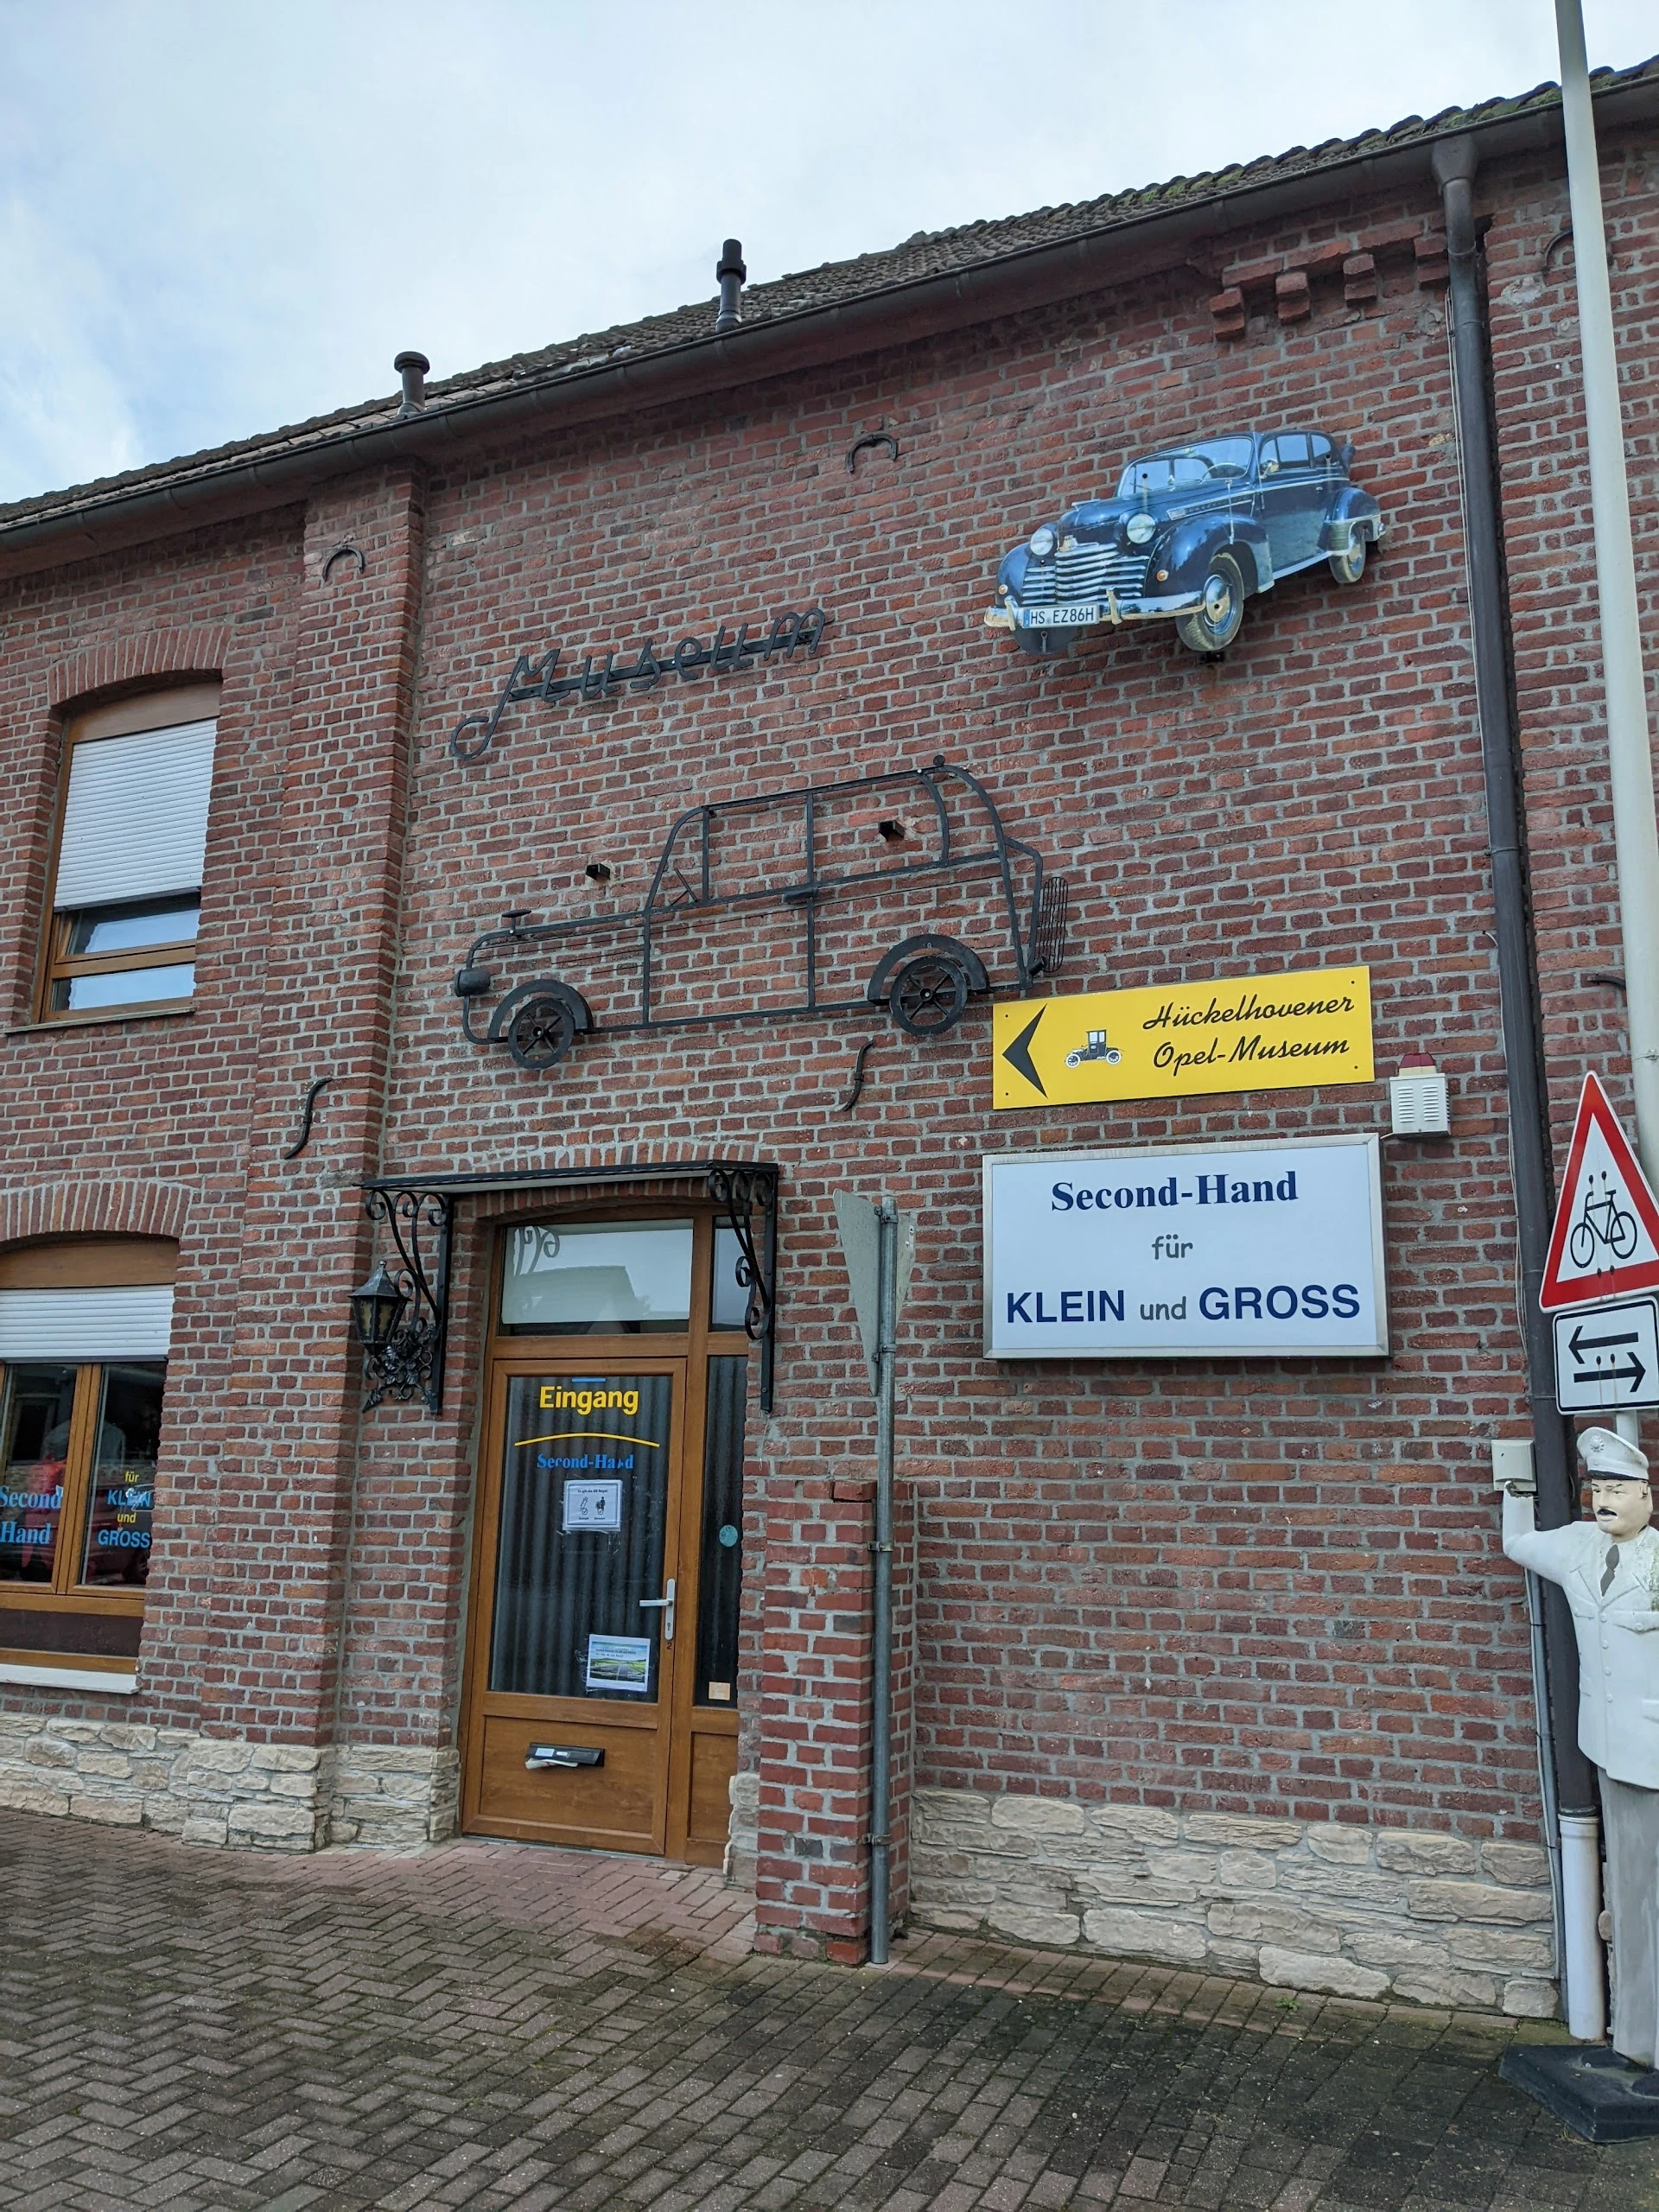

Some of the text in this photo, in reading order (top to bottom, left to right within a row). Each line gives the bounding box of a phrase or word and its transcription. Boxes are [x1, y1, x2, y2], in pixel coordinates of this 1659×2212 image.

[1031, 607, 1094, 624] HS EZ86H
[448, 608, 826, 760] Museum
[1142, 994, 1355, 1030] Hückelhovener
[1154, 1034, 1350, 1077] Opel-Museum
[1051, 1171, 1299, 1211] Second-Hand
[1152, 1234, 1193, 1260] für
[1007, 1284, 1361, 1324] KLEIN und GROSS
[539, 1386, 639, 1415] Eingang
[124, 1471, 140, 1483] für
[0, 1485, 63, 1510] Second
[117, 1512, 137, 1523] und
[0, 1521, 52, 1545] Hand
[98, 1529, 150, 1549] GROSS
